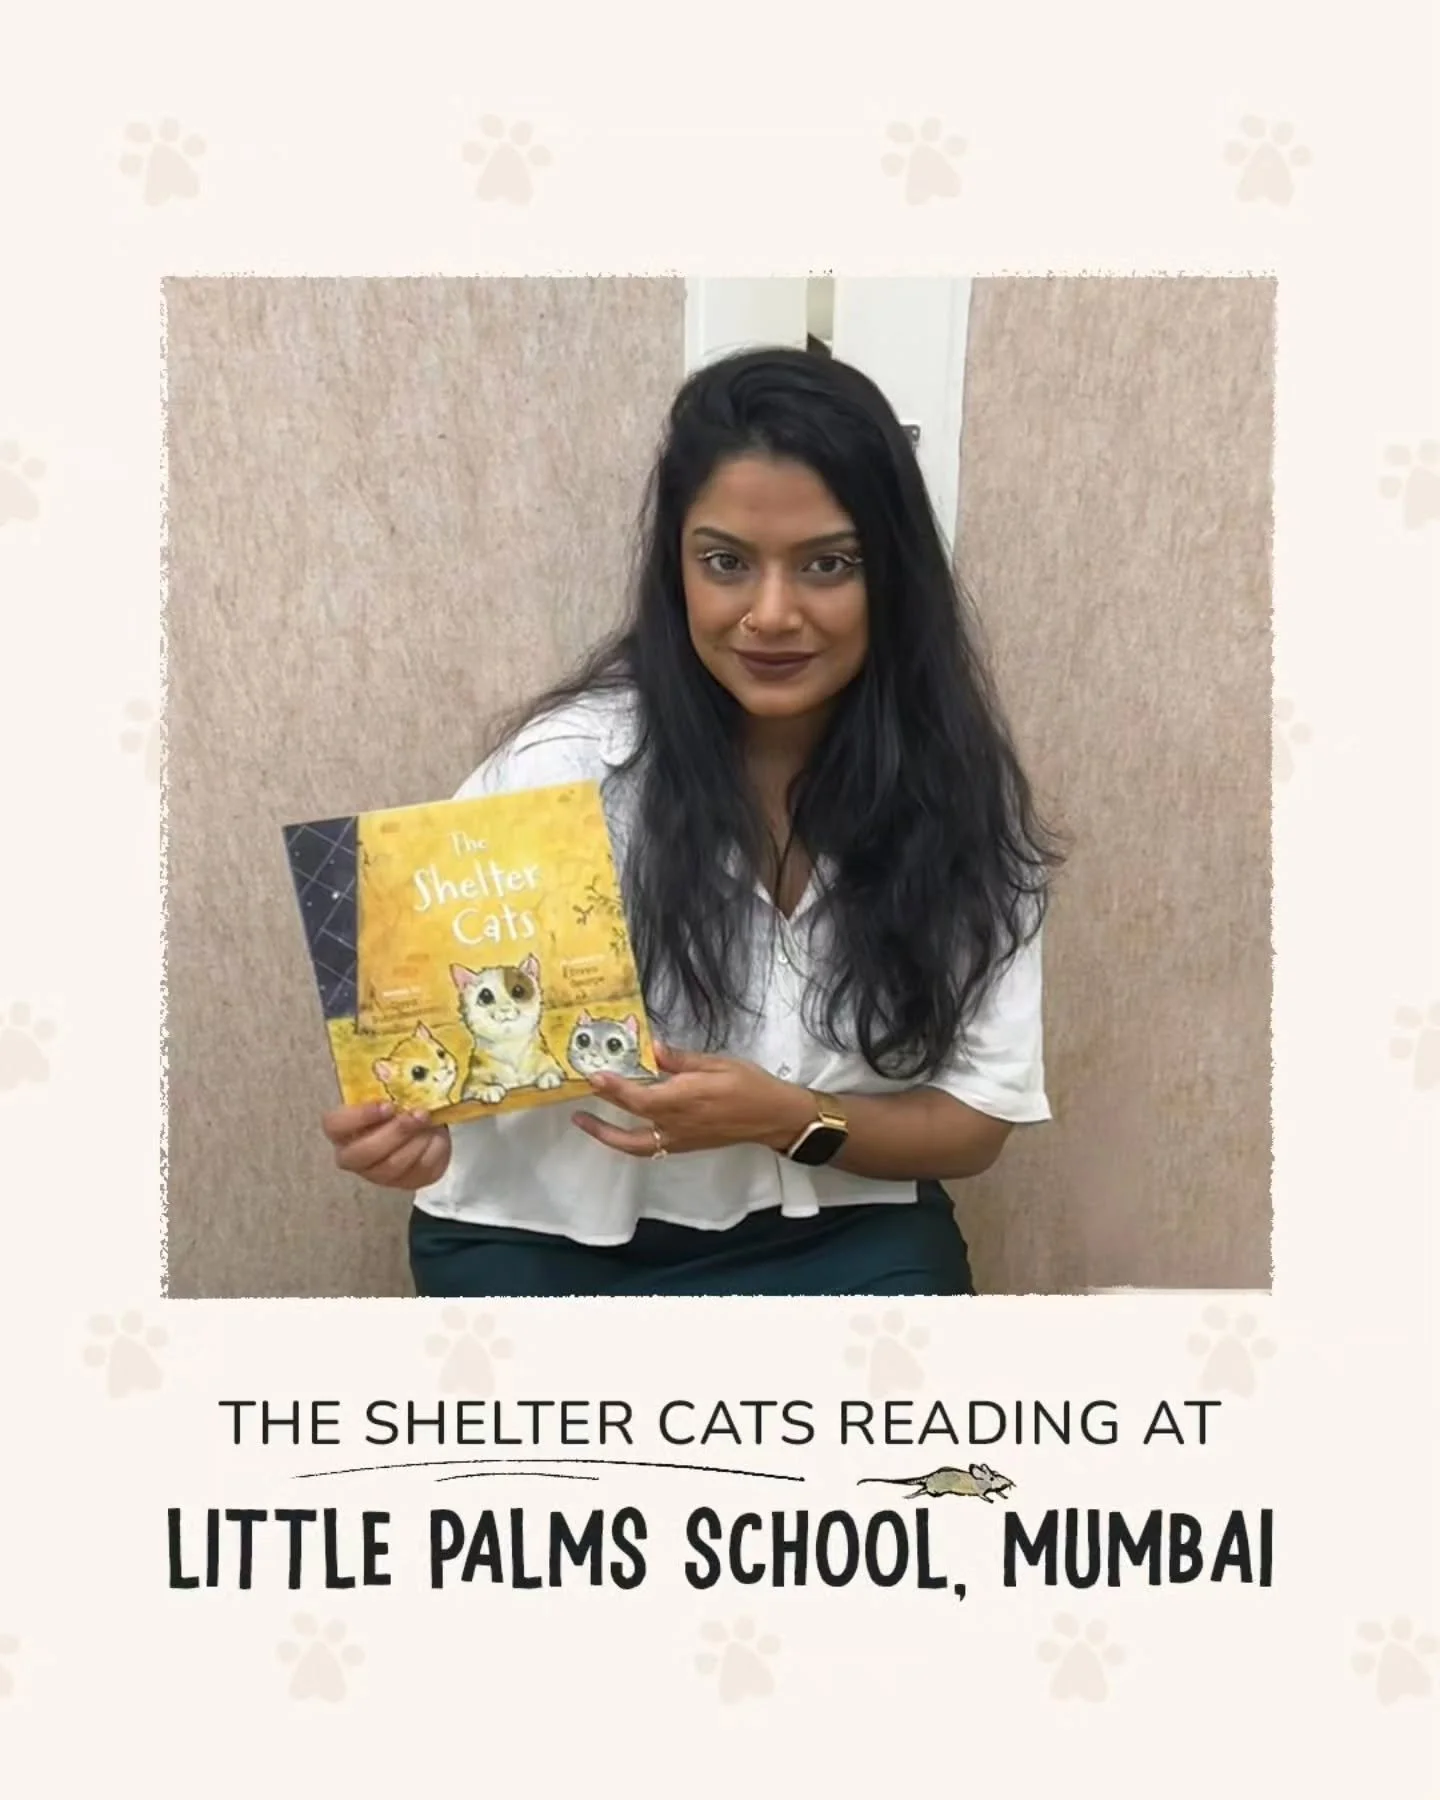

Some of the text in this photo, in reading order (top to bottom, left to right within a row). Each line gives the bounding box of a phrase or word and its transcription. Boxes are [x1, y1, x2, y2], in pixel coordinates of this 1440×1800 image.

[448, 830, 488, 857] The
[413, 859, 540, 912] Shelter
[451, 903, 536, 945] Cats
